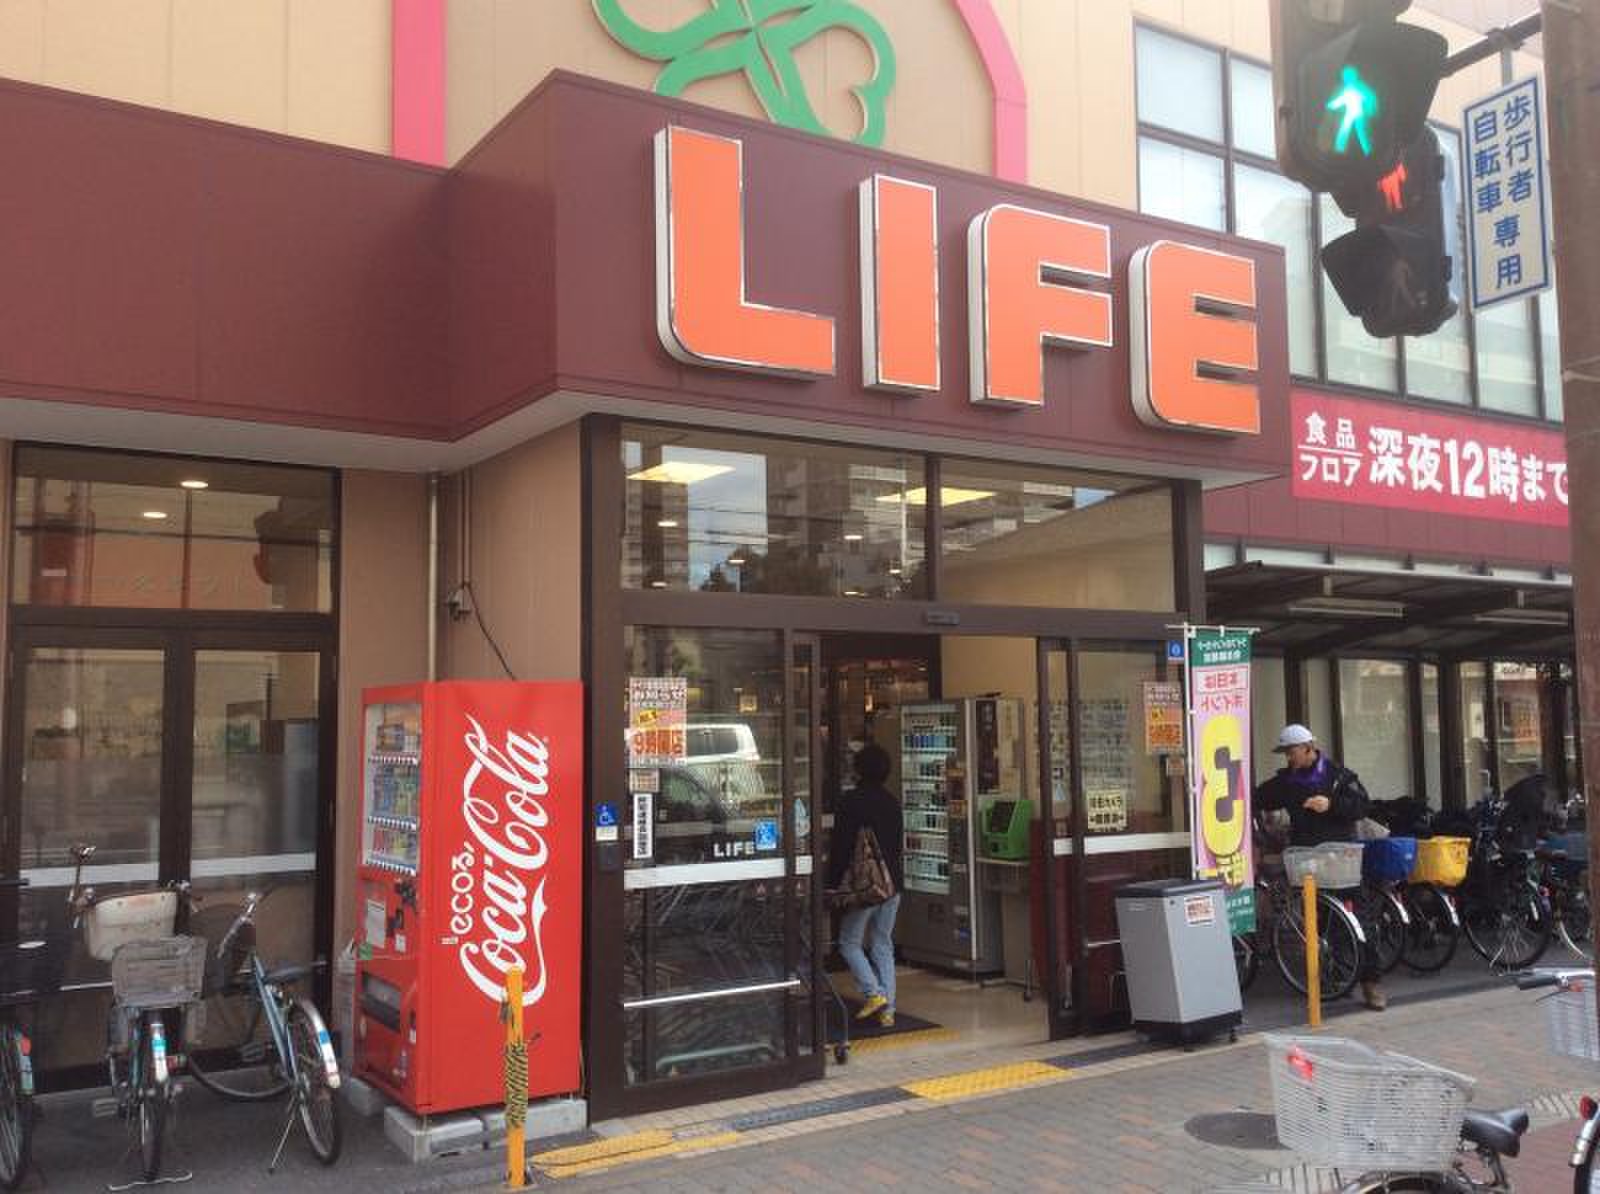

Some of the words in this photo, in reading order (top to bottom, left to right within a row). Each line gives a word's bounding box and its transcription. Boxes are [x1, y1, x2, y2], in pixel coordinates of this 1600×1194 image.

[1474, 110, 1503, 213] 自転車
[1504, 95, 1534, 201] 歩行者
[654, 126, 1260, 436] LIFE
[1493, 214, 1523, 288] 専用
[1299, 453, 1362, 486] フロア
[1304, 411, 1358, 449] 食品
[460, 712, 549, 1007] Coca-Cola
[713, 842, 756, 857] LIFE
